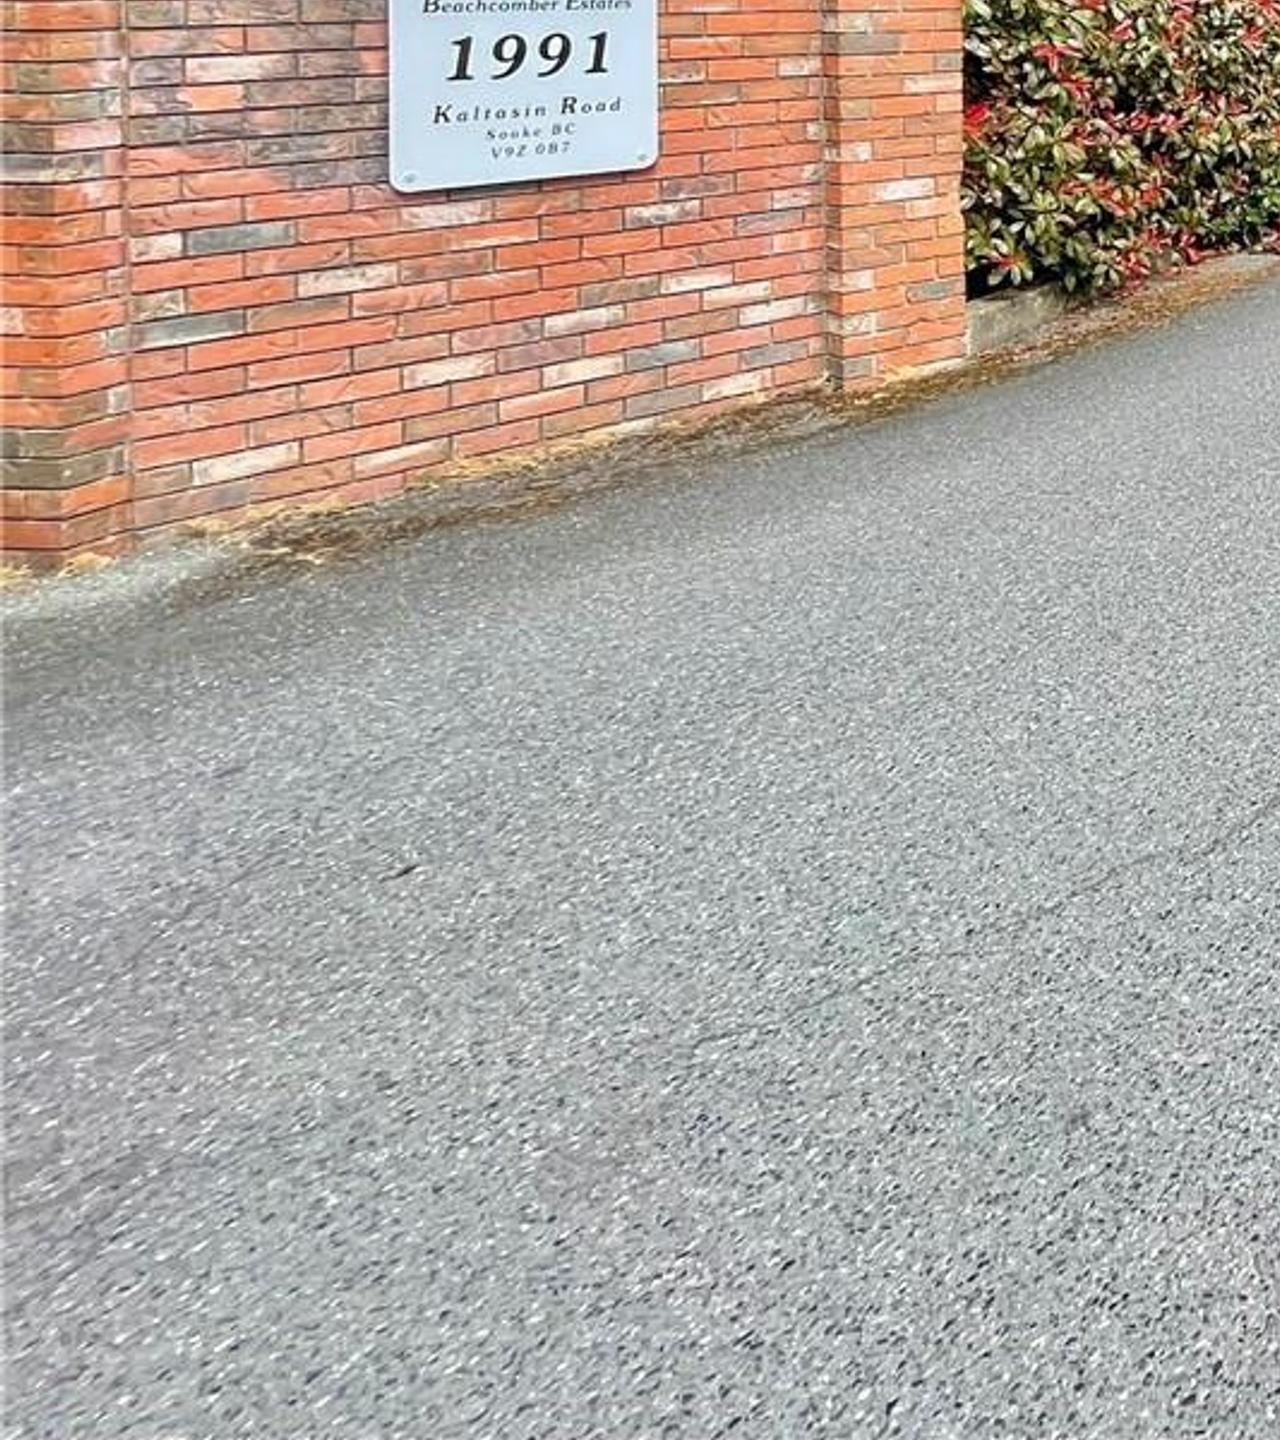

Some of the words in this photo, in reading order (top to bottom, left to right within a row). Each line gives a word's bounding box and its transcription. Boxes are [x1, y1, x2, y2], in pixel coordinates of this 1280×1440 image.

[446, 31, 609, 81] 1991
[433, 104, 547, 124] Kaltasin
[561, 96, 622, 115] Road
[486, 127, 541, 141] Sooke
[552, 122, 577, 136] BC
[491, 144, 526, 159] V9Z
